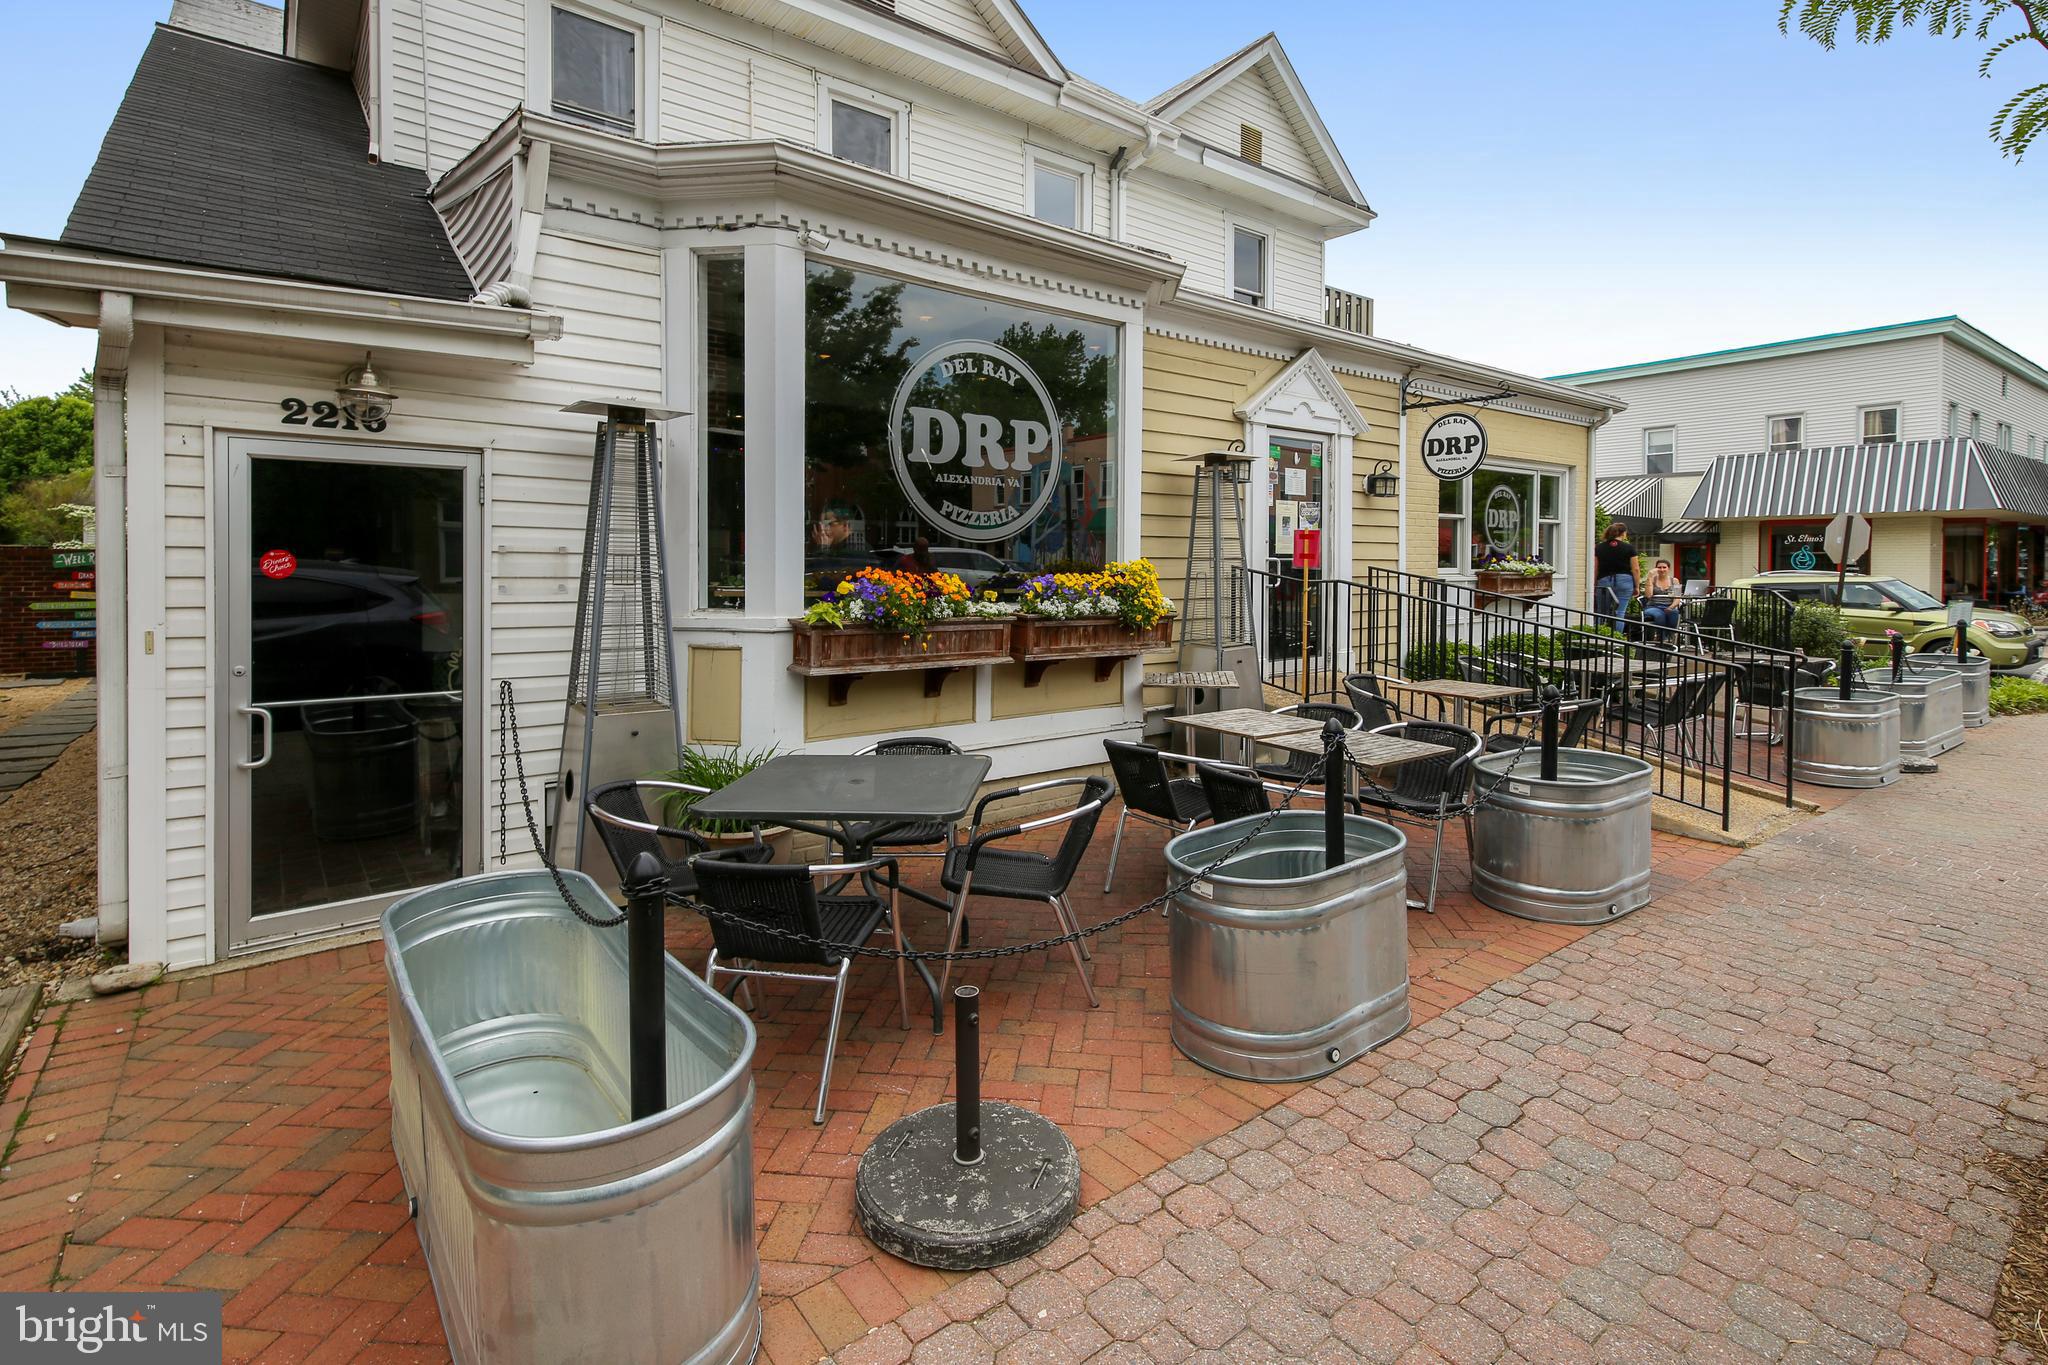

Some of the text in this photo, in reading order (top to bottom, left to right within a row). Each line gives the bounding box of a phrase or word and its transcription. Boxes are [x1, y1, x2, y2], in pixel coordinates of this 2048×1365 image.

[939, 358, 1021, 387] DEL RAY
[1437, 419, 1451, 428] DEL
[907, 406, 1049, 471] DRP
[1426, 434, 1480, 457] DRP
[935, 473, 1021, 488] ALEXANDRIA, VA
[1437, 466, 1467, 475] PIZZERIA
[939, 500, 1021, 526] PIZZERIA
[1488, 508, 1517, 528] DRP
[1784, 533, 1824, 545] St. Elmo's
